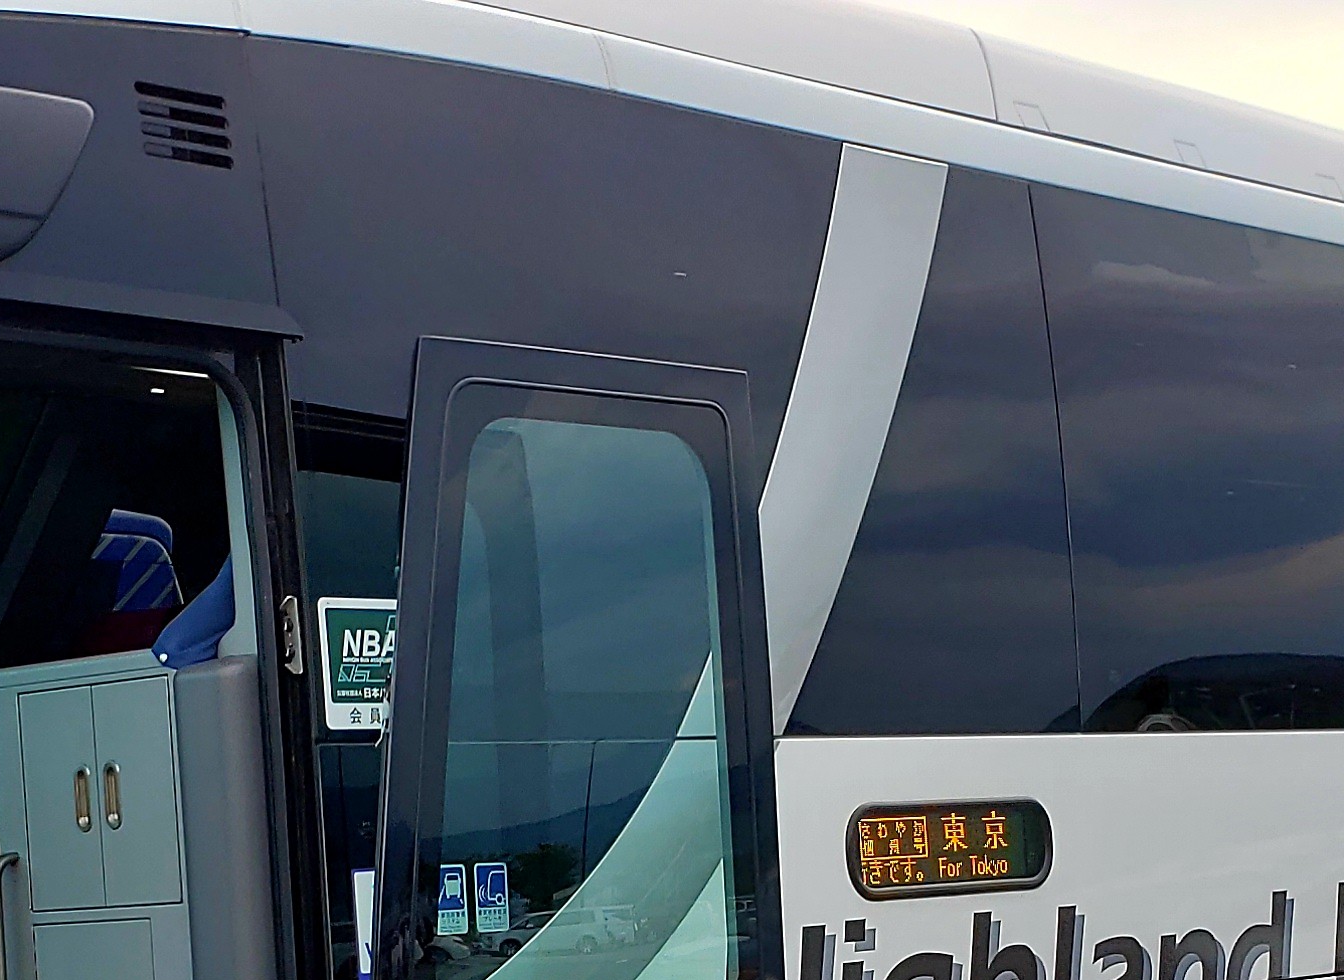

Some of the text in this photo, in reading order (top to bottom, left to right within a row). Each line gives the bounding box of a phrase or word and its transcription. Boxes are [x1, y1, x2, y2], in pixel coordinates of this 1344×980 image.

[342, 629, 396, 657] NBA
[940, 810, 1009, 852] 東京
[938, 854, 1009, 879] For Tokyo
